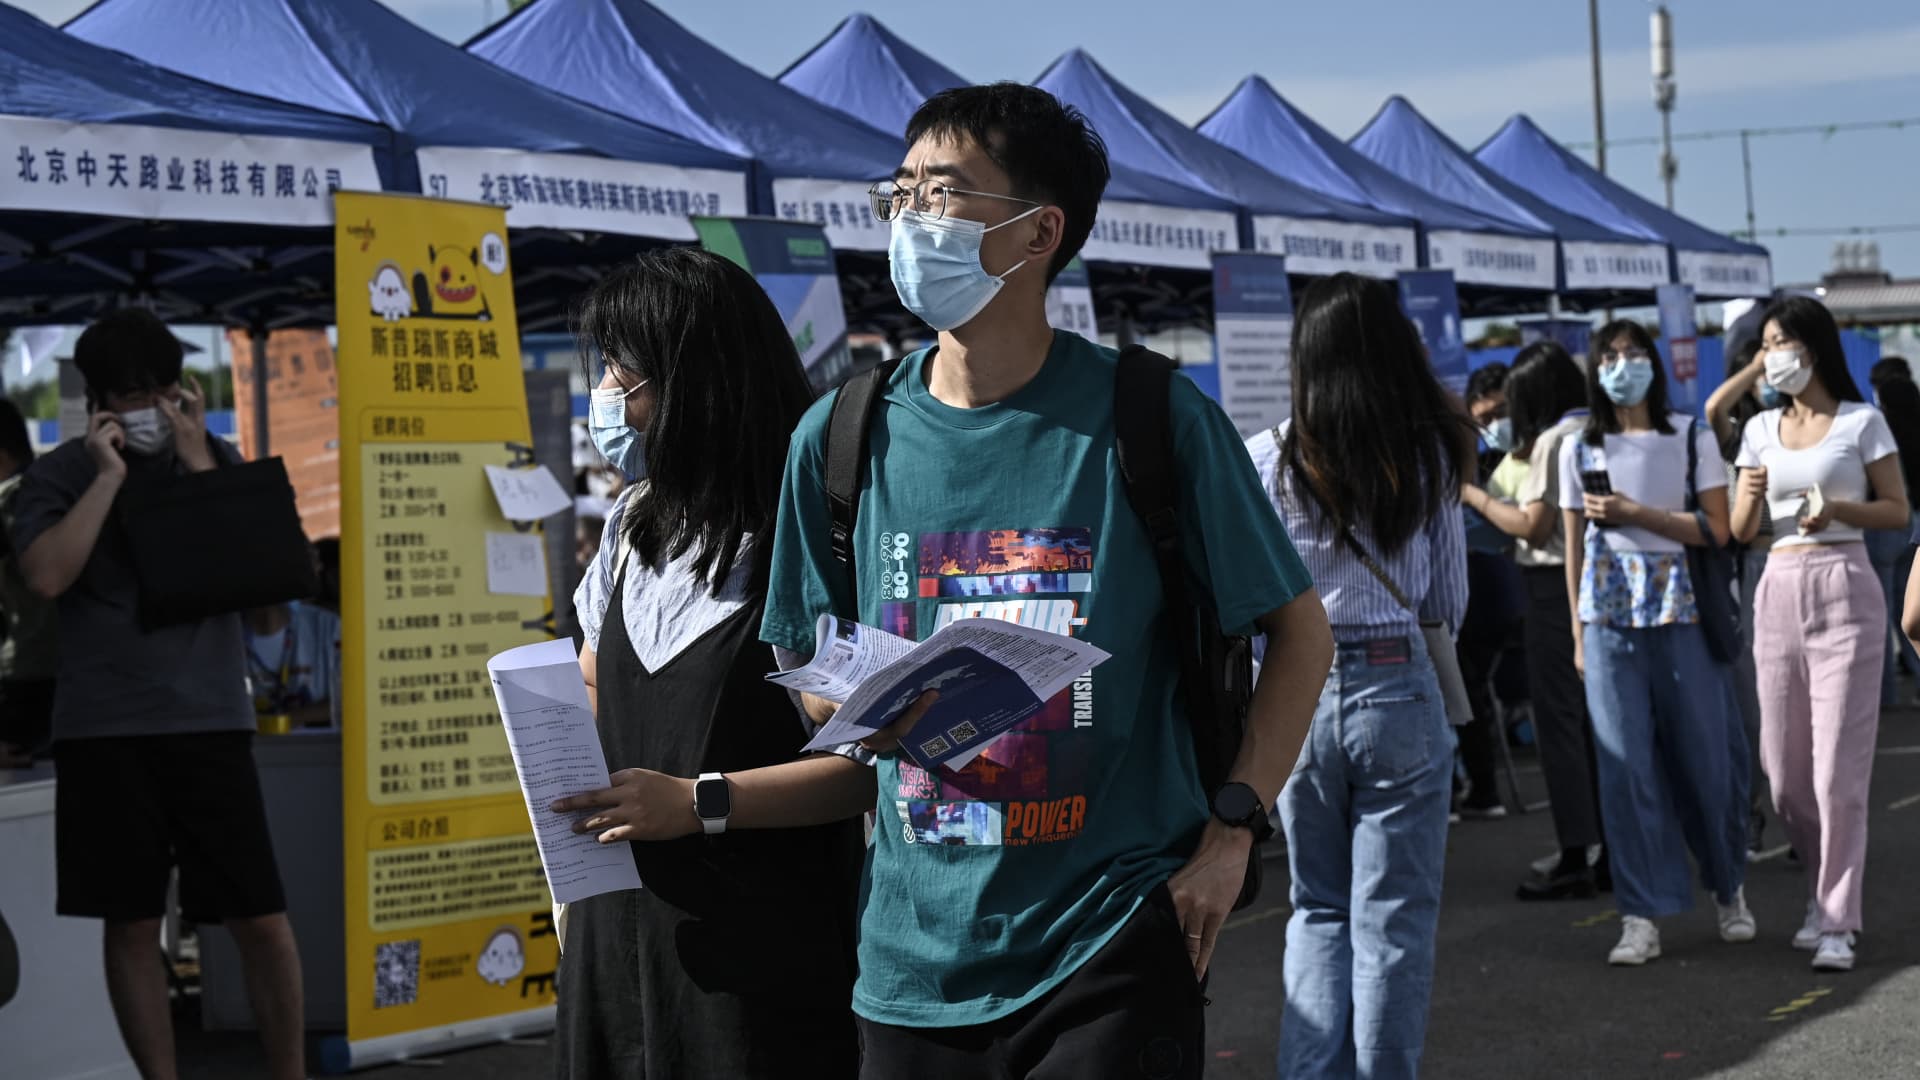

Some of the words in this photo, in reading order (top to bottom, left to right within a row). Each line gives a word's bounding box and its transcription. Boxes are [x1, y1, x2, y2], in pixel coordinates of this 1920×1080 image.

[17, 145, 342, 198] 北京中天路业科技有限公司
[371, 326, 499, 359] 斯普瑞斯商城
[393, 362, 478, 393] 招聘信息
[899, 769, 935, 785] VISUAL
[1004, 795, 1087, 838] POWER
